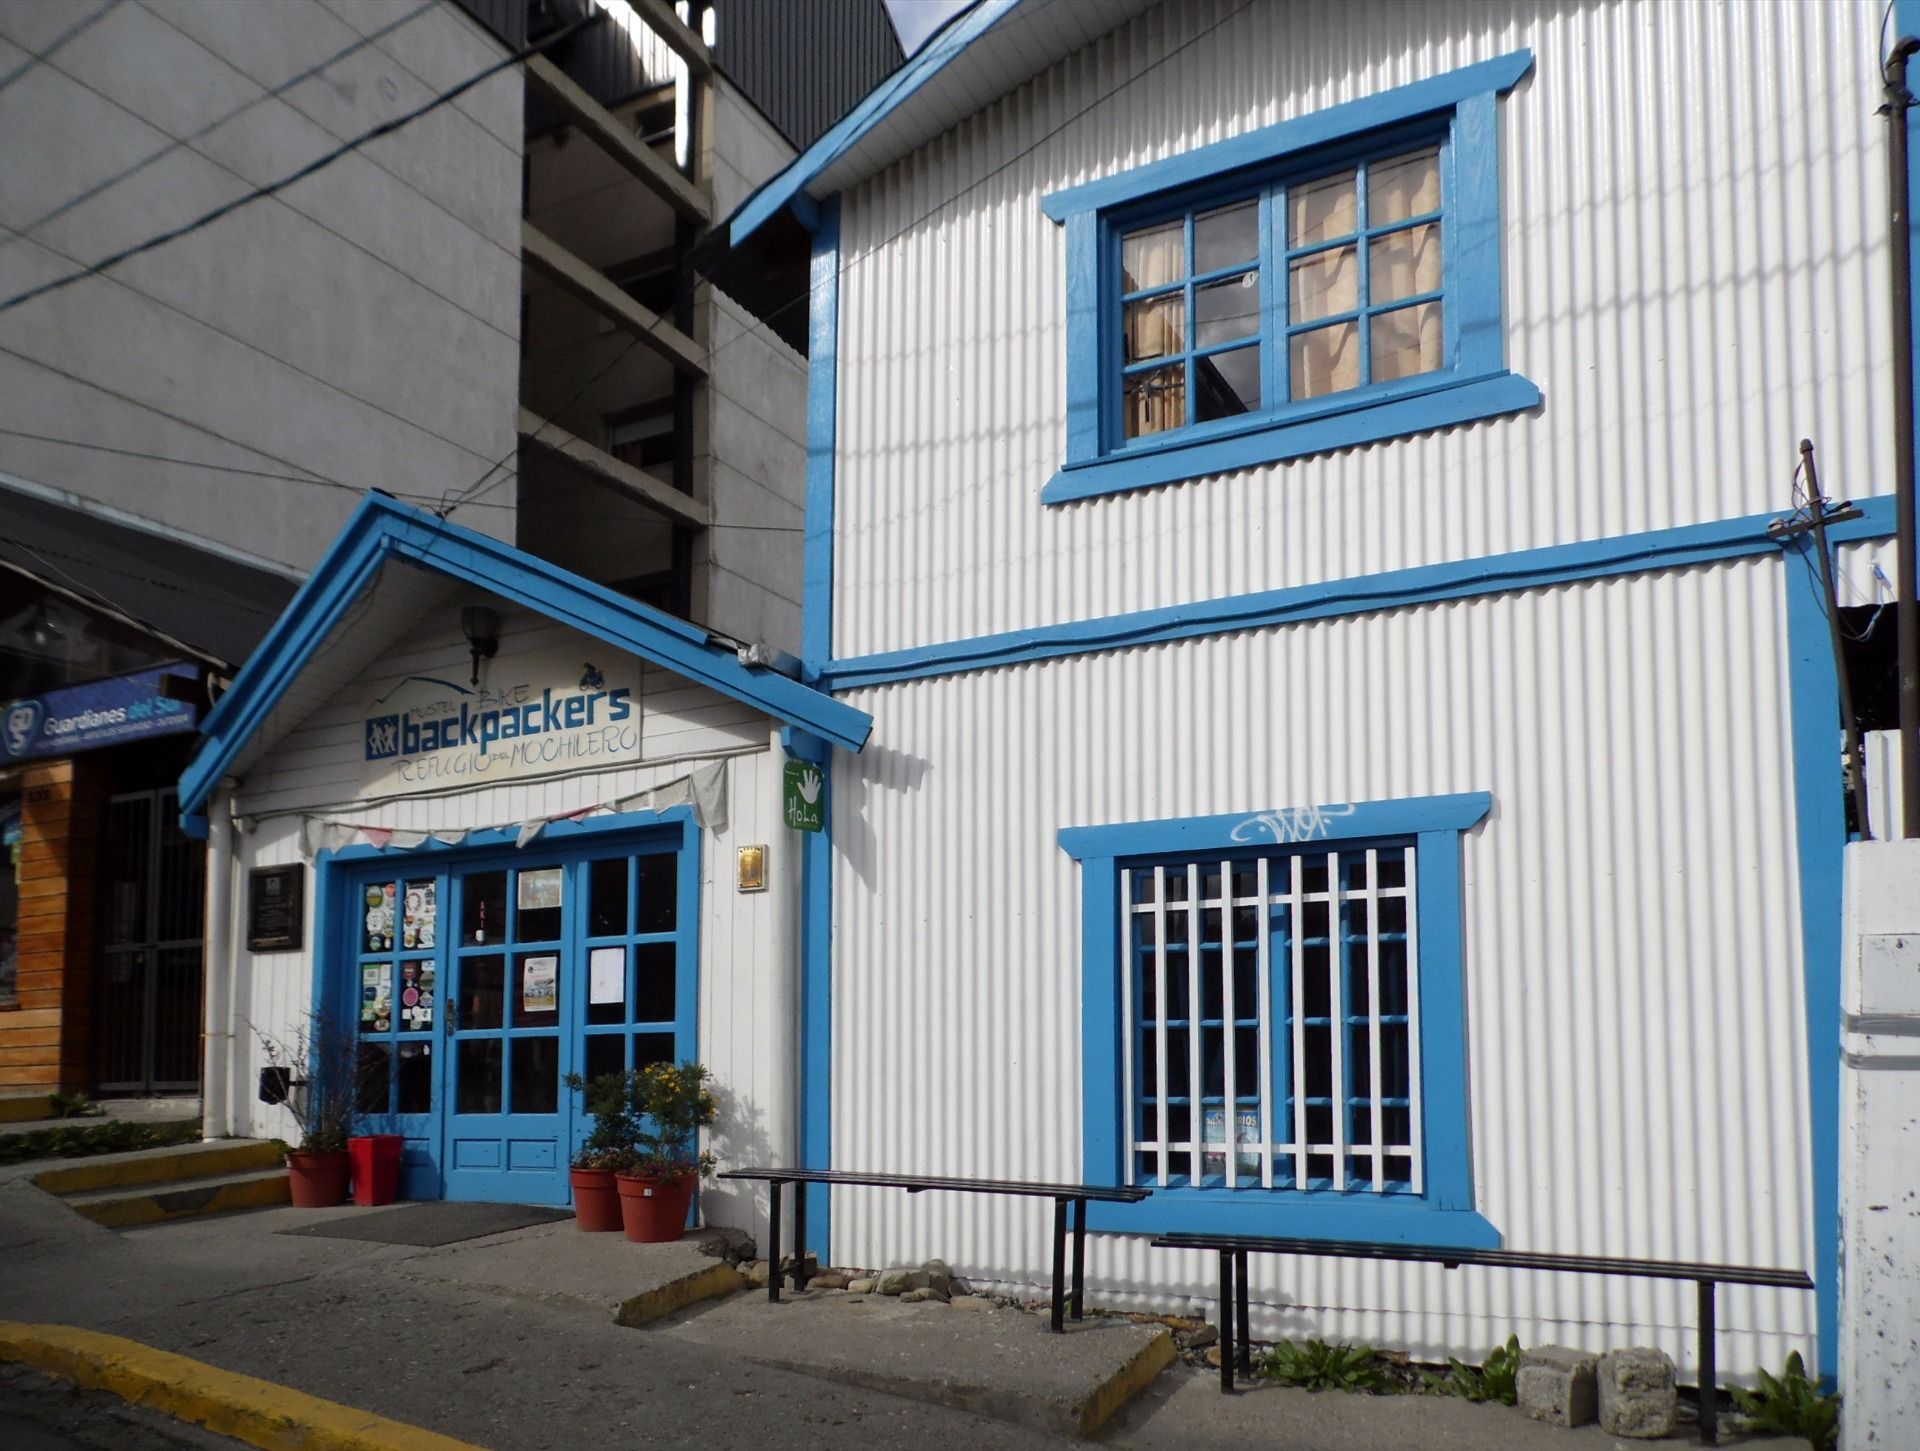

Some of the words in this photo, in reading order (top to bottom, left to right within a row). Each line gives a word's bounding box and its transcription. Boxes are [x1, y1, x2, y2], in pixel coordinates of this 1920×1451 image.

[44, 707, 127, 735] Guardianes
[402, 688, 630, 755] backpackers
[410, 702, 457, 720] HOSTEL
[478, 685, 531, 708] BIKE
[391, 753, 492, 782] REFUGIO
[510, 725, 638, 768] MOCHILERO
